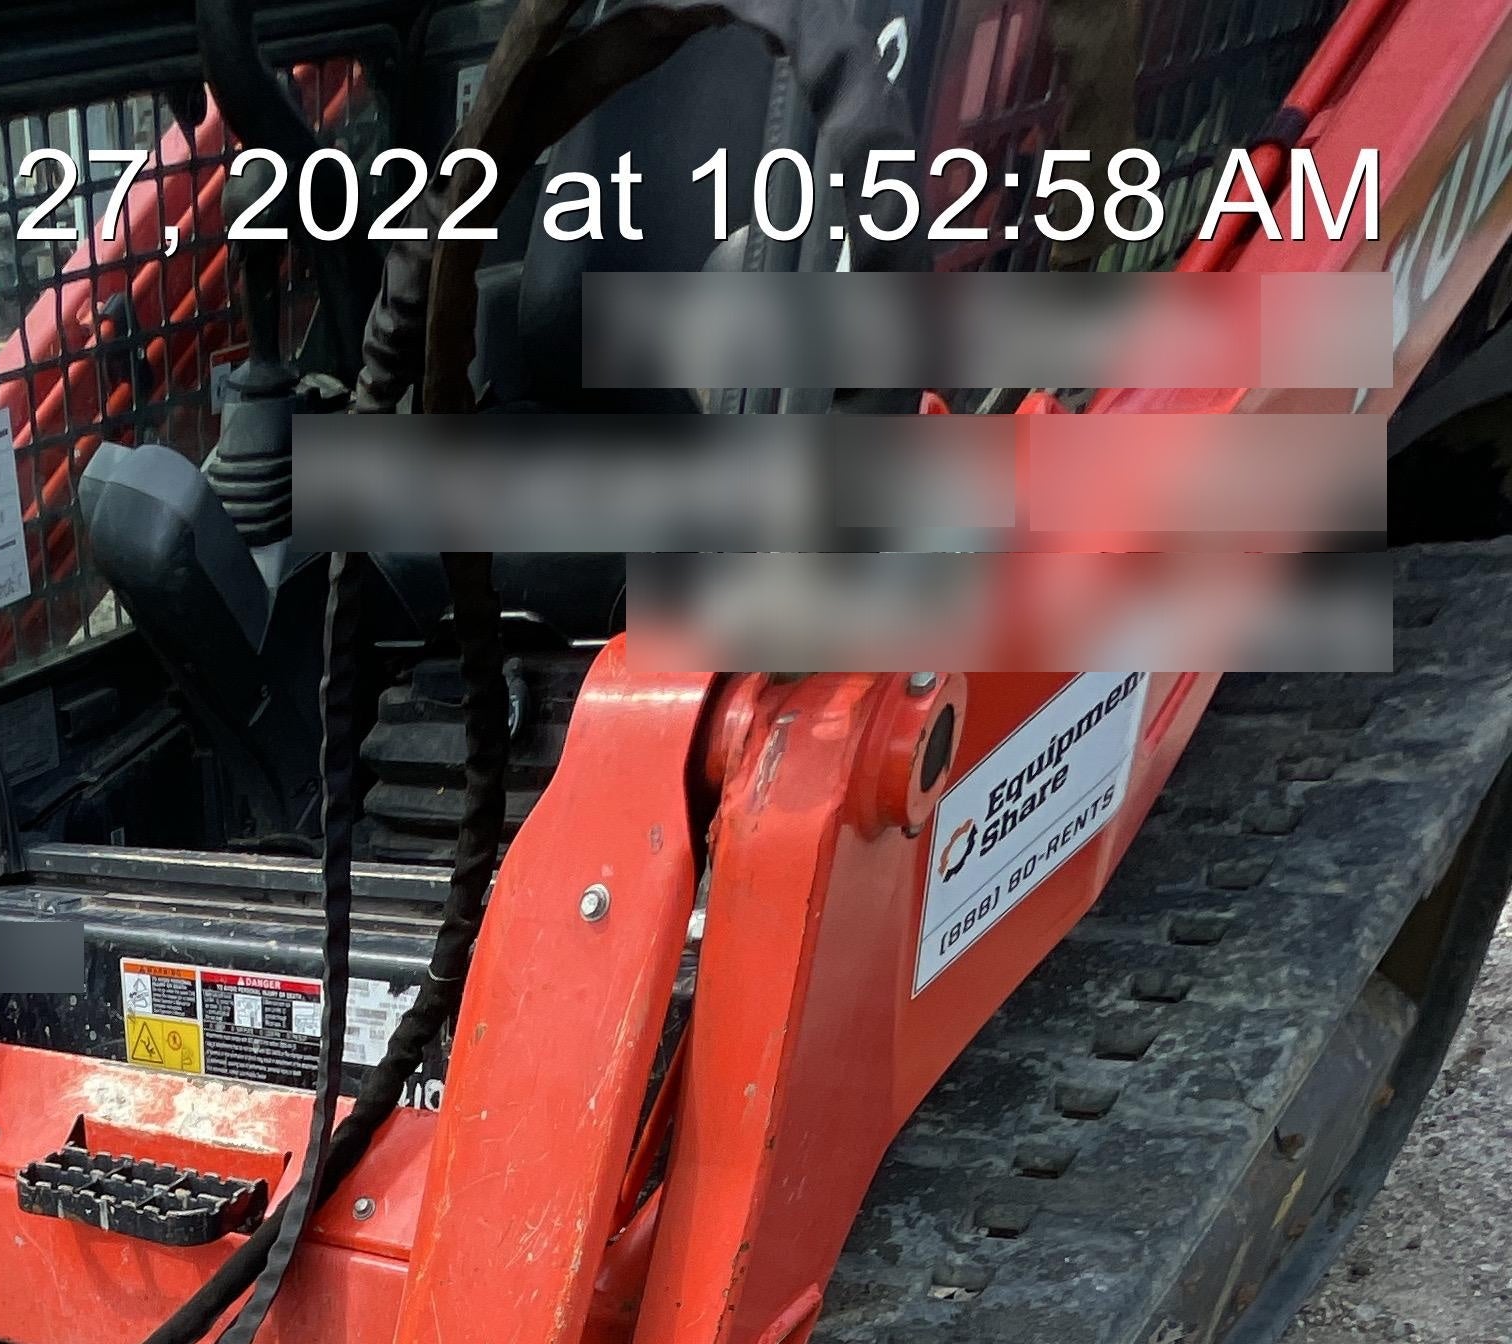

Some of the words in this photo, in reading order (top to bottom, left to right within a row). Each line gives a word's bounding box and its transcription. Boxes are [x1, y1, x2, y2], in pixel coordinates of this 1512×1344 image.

[985, 671, 1146, 820] Equipmen
[979, 763, 1070, 858] Share
[939, 884, 1001, 957] (888)
[245, 977, 282, 990] DANGER
